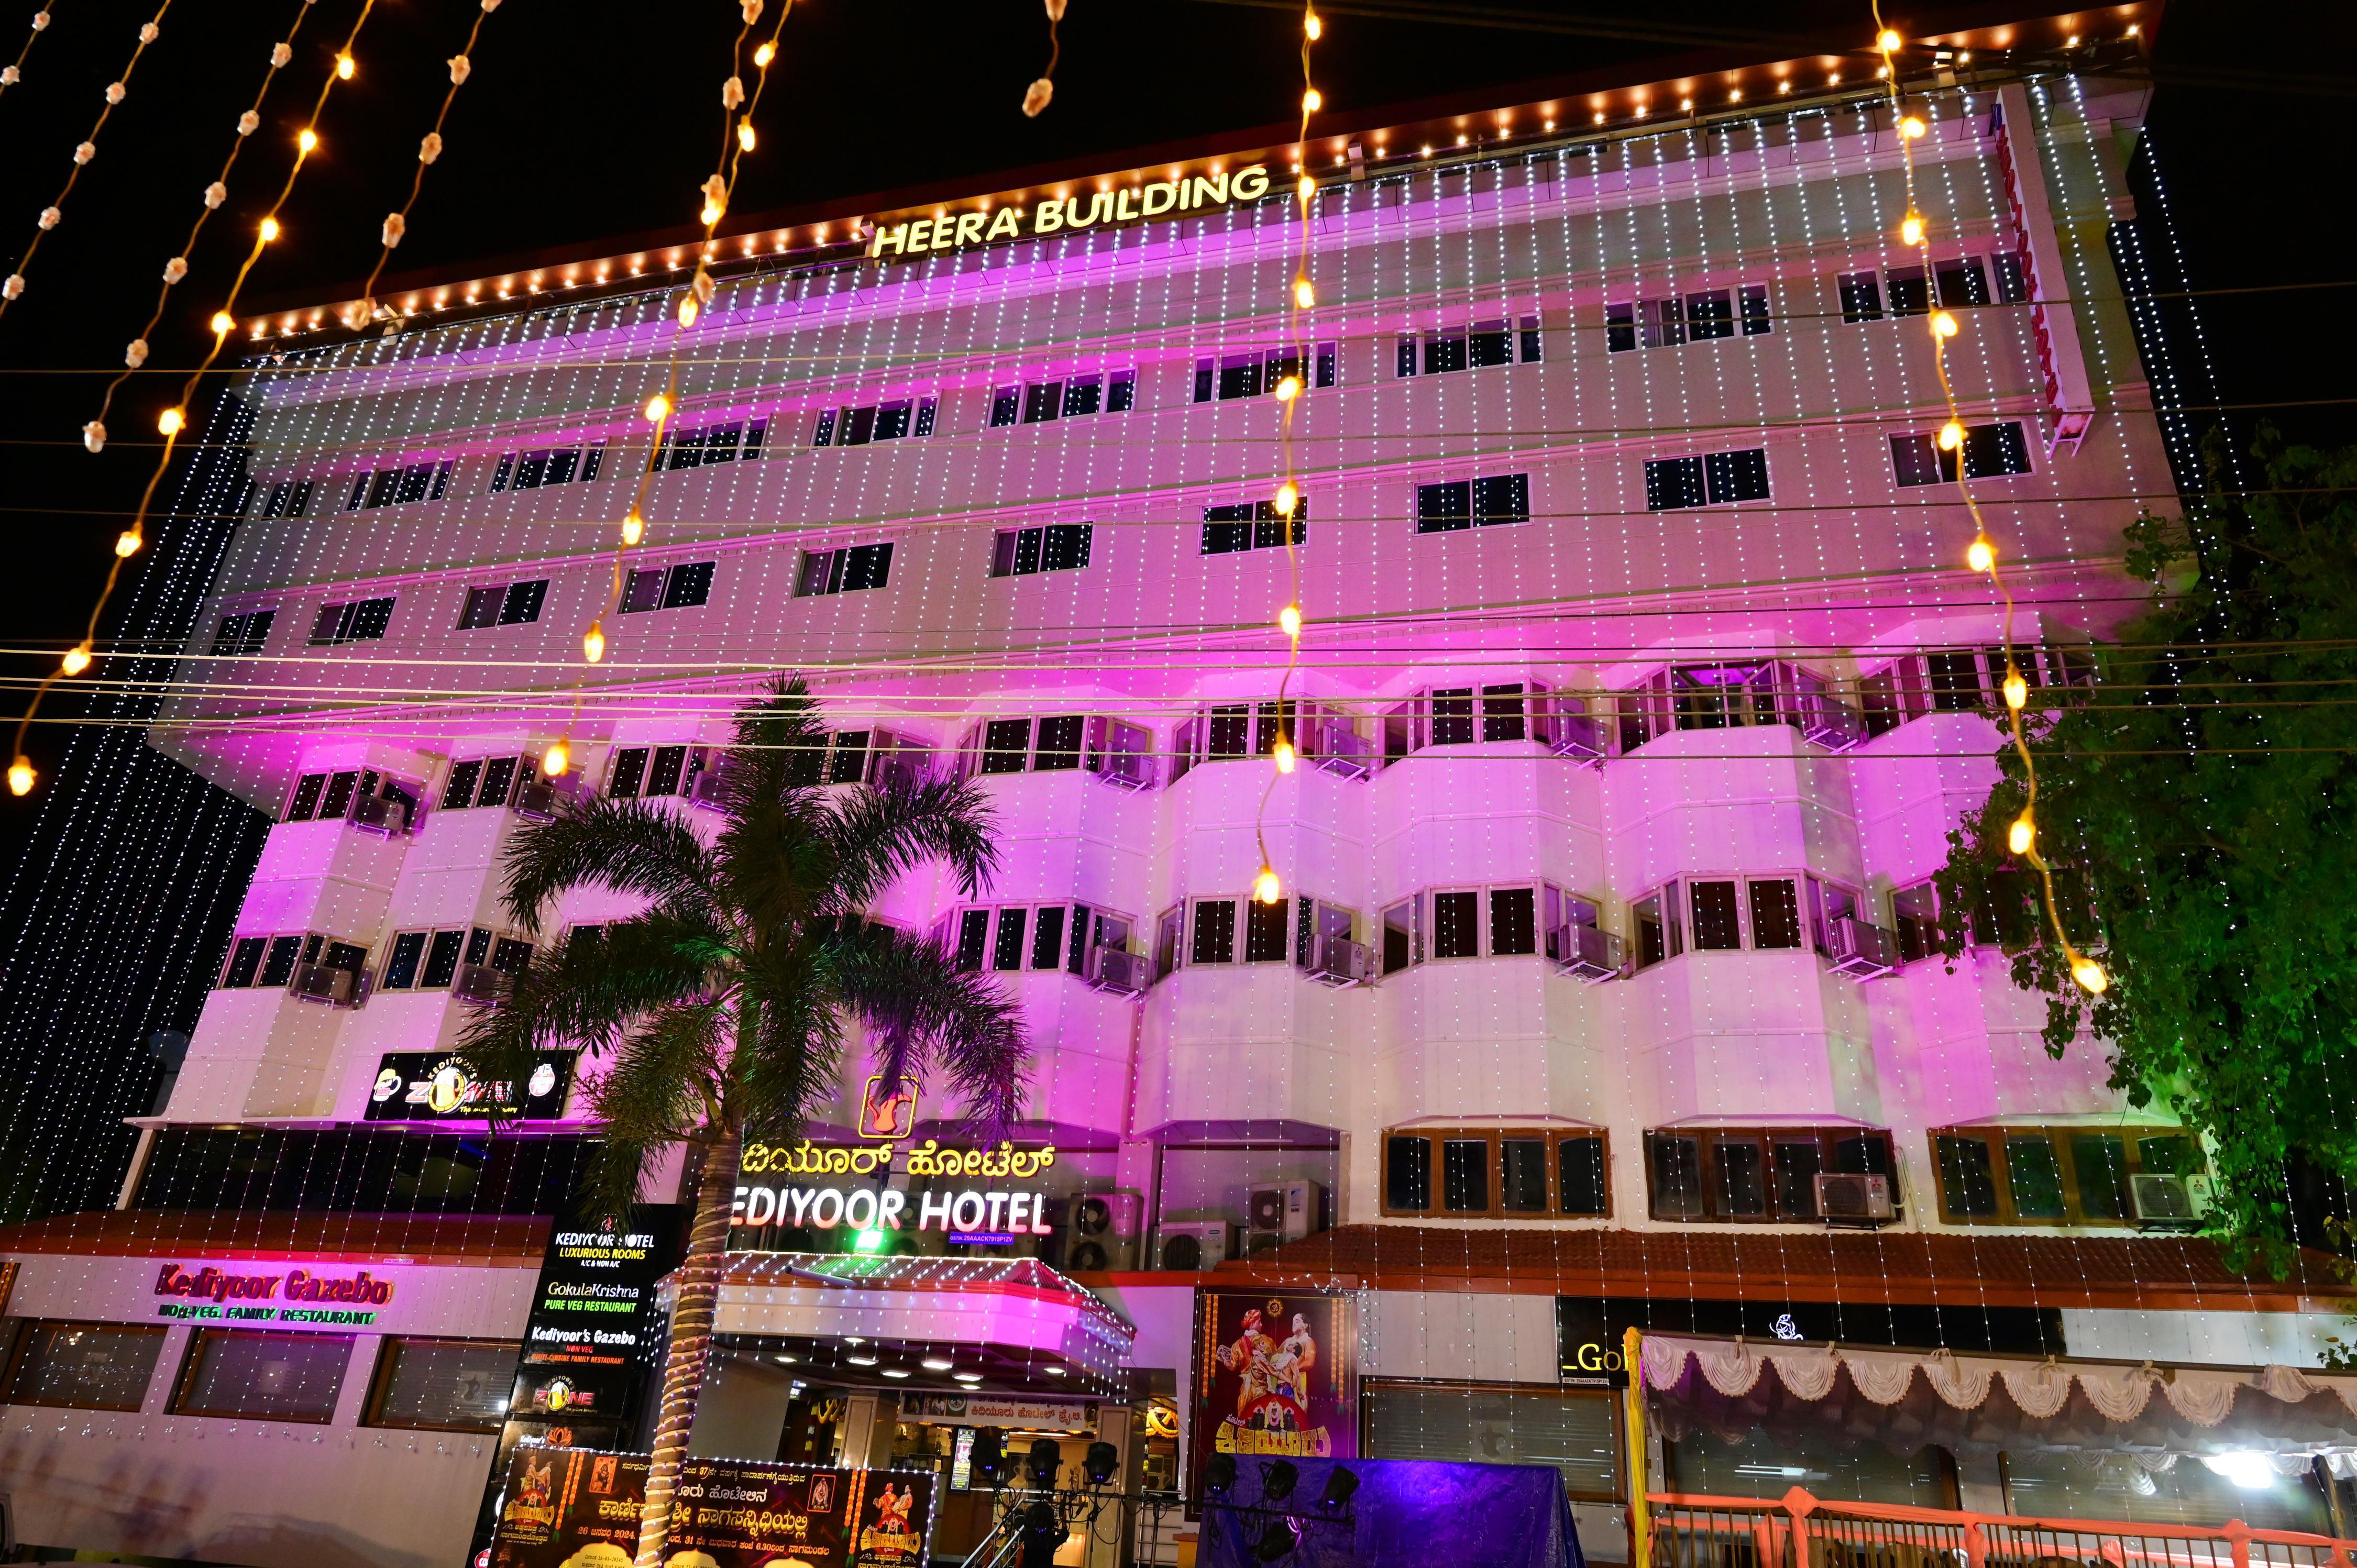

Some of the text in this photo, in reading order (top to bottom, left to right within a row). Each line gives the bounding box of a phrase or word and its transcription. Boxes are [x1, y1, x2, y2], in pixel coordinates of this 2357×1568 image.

[872, 167, 1269, 258] HEERA BUILDING
[427, 1057, 478, 1079] KEDIYO'S
[730, 1186, 1052, 1234] EDIYOOR HOTEL
[559, 1247, 646, 1260] LUXURIOUS ROOMS
[155, 1264, 394, 1305] Kediyoor Gazebo
[548, 1282, 639, 1298] GokulaKrishna
[544, 1299, 636, 1313] PURE VEG RESTAURANT
[226, 1307, 277, 1322] FAMILY
[280, 1310, 376, 1325] RESTAURANT
[532, 1327, 635, 1345] Kediyoor's Gazebo
[590, 1356, 624, 1364] RESTAURANT
[578, 1526, 588, 1534] 26
[685, 1536, 693, 1544] 31
